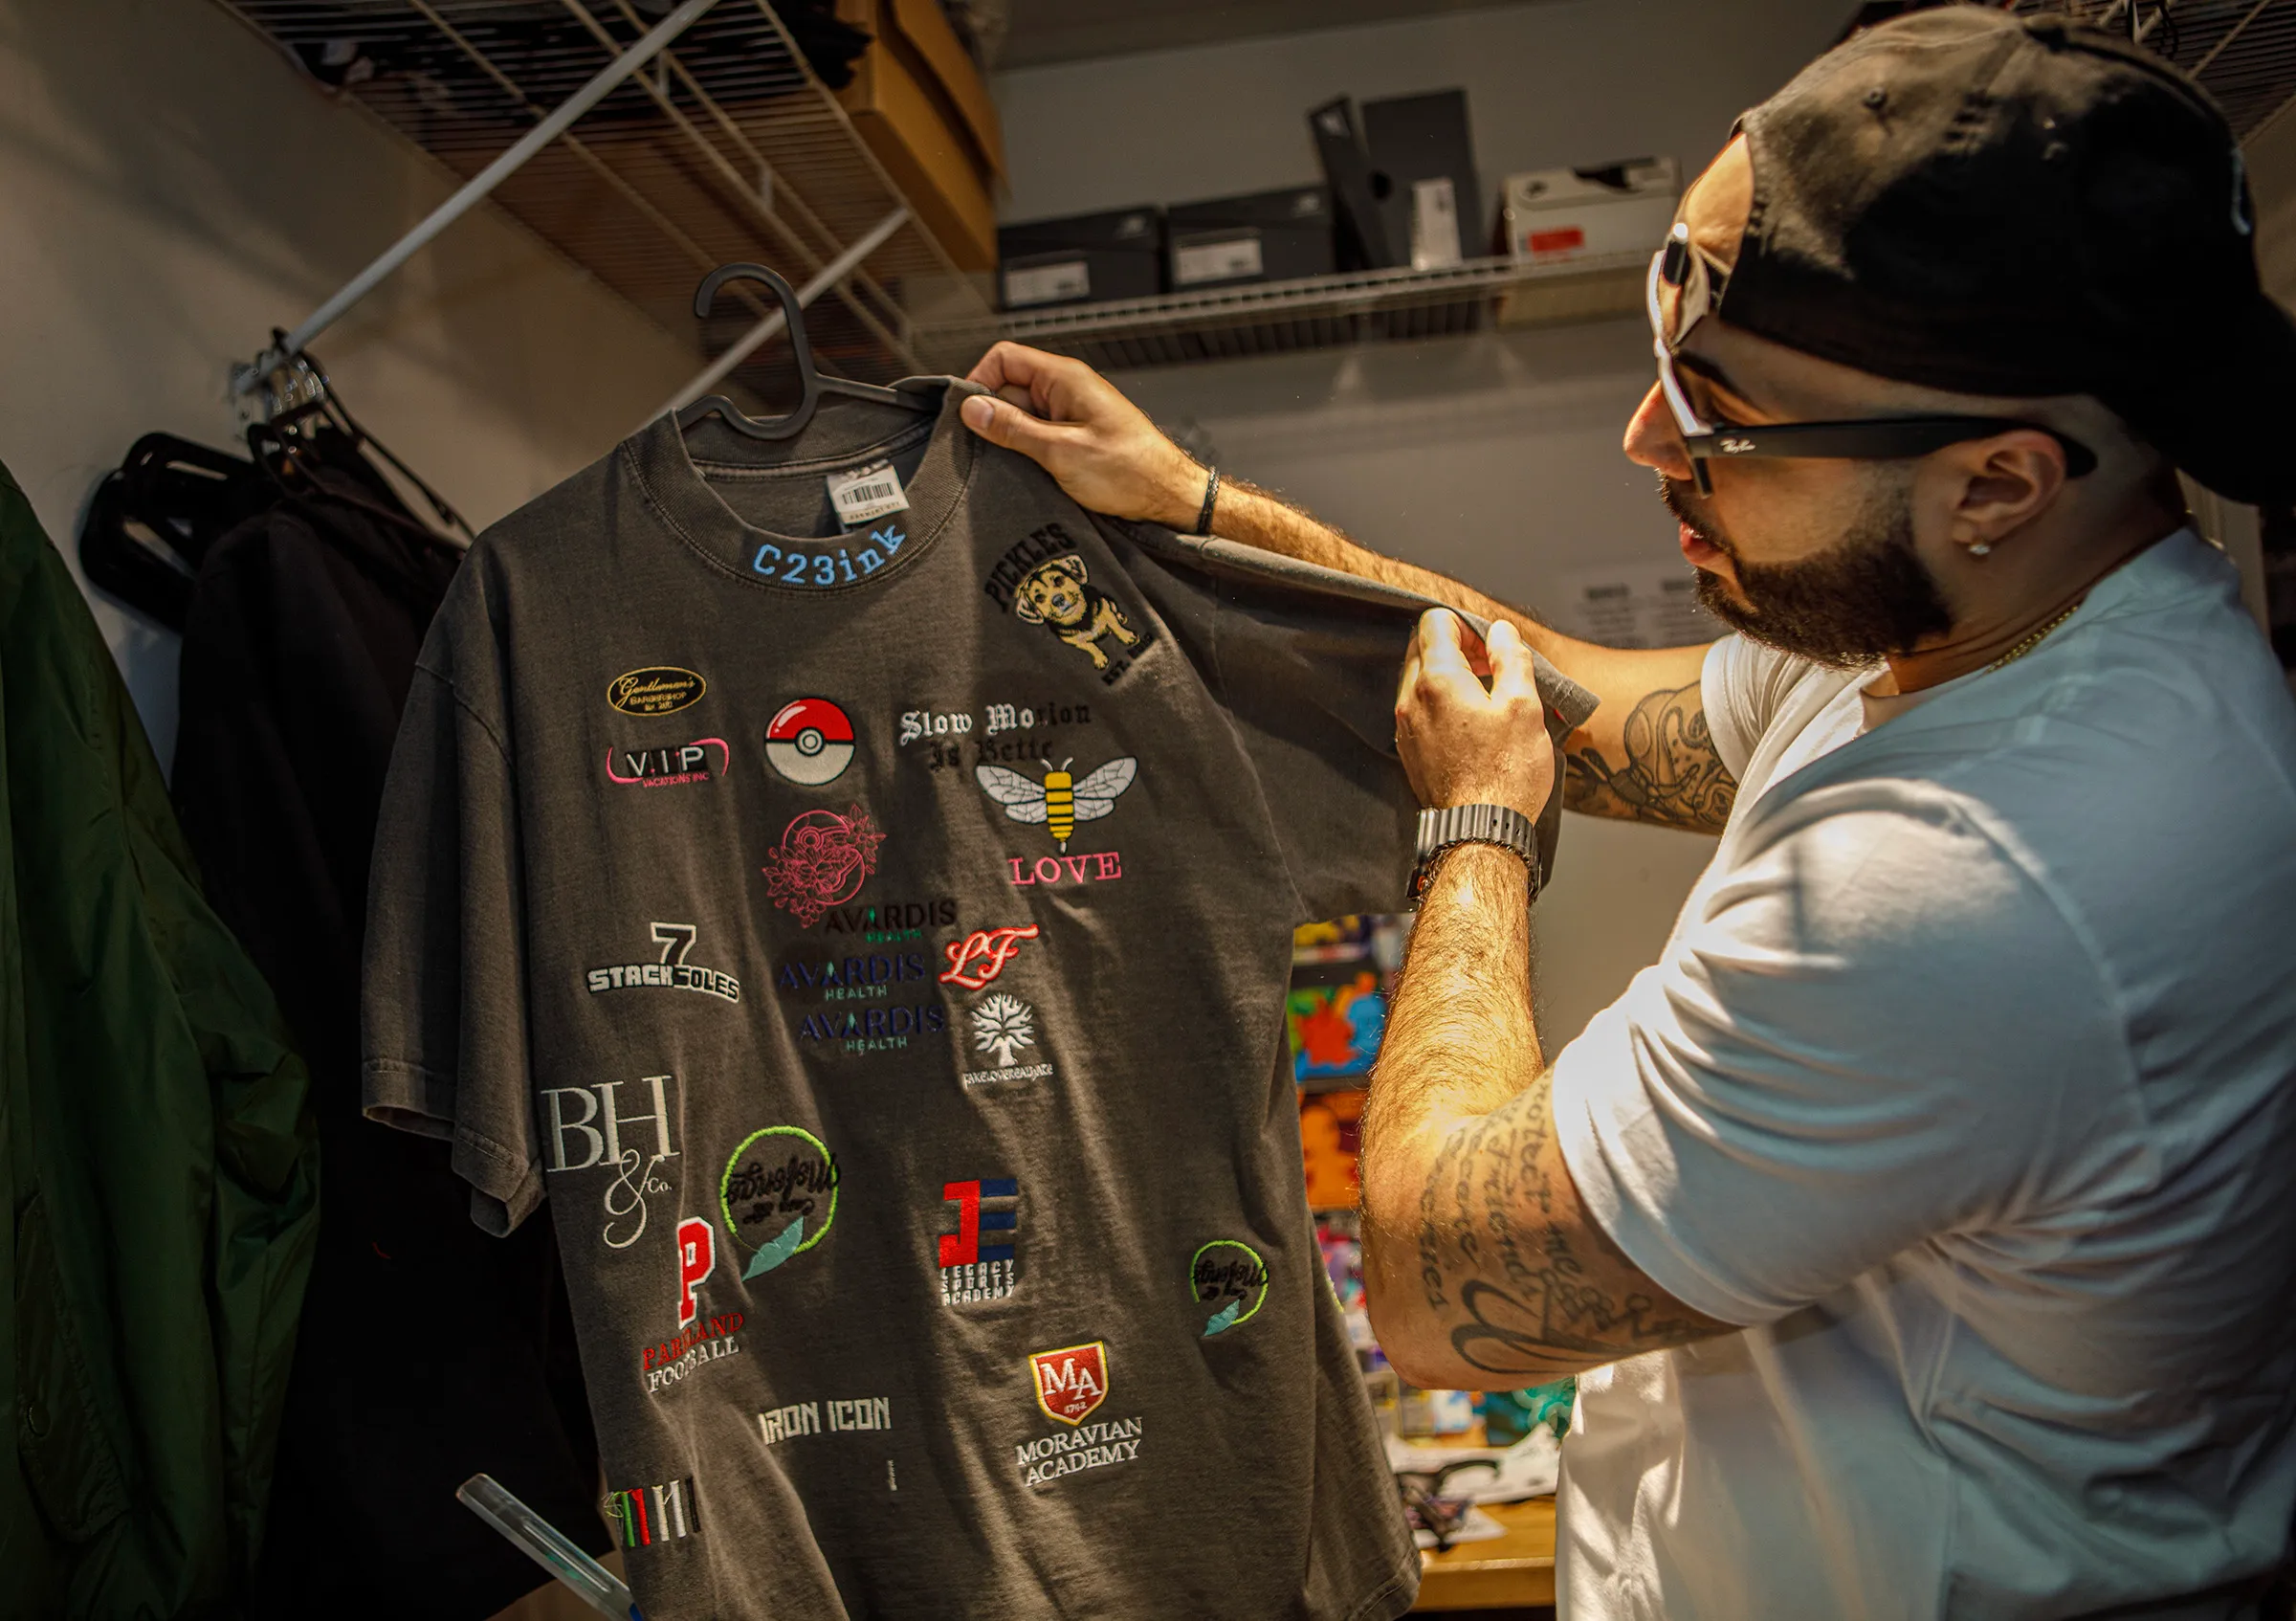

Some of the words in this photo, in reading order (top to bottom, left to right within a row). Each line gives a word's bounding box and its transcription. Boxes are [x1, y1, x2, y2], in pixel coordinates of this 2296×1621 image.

[753, 524, 906, 586] C23ink
[984, 522, 1077, 614] PICKLES
[899, 710, 973, 746] Slow
[642, 773, 691, 788] VACATIONS
[693, 771, 710, 783] INC
[1007, 851, 1122, 886] LOVE
[826, 899, 957, 934] AVARDIS
[650, 922, 697, 965] 7
[867, 929, 922, 944] HEALTH
[779, 954, 925, 989] AVARDIS
[825, 985, 888, 1002] HEALTH
[800, 1006, 945, 1041] AVARDIS
[846, 1036, 908, 1054] HEALTH
[541, 1076, 680, 1173] BH
[676, 1215, 716, 1330] P
[940, 1259, 1014, 1280] LEGACY
[940, 1272, 1014, 1293] SPORTS
[941, 1285, 1014, 1307] ACADEMY
[1040, 1358, 1102, 1401] MA
[758, 1402, 821, 1445] IRON
[827, 1396, 892, 1432] ICON
[1015, 1416, 1143, 1467] MORAVIAN
[1026, 1438, 1141, 1488] ACADEMY
